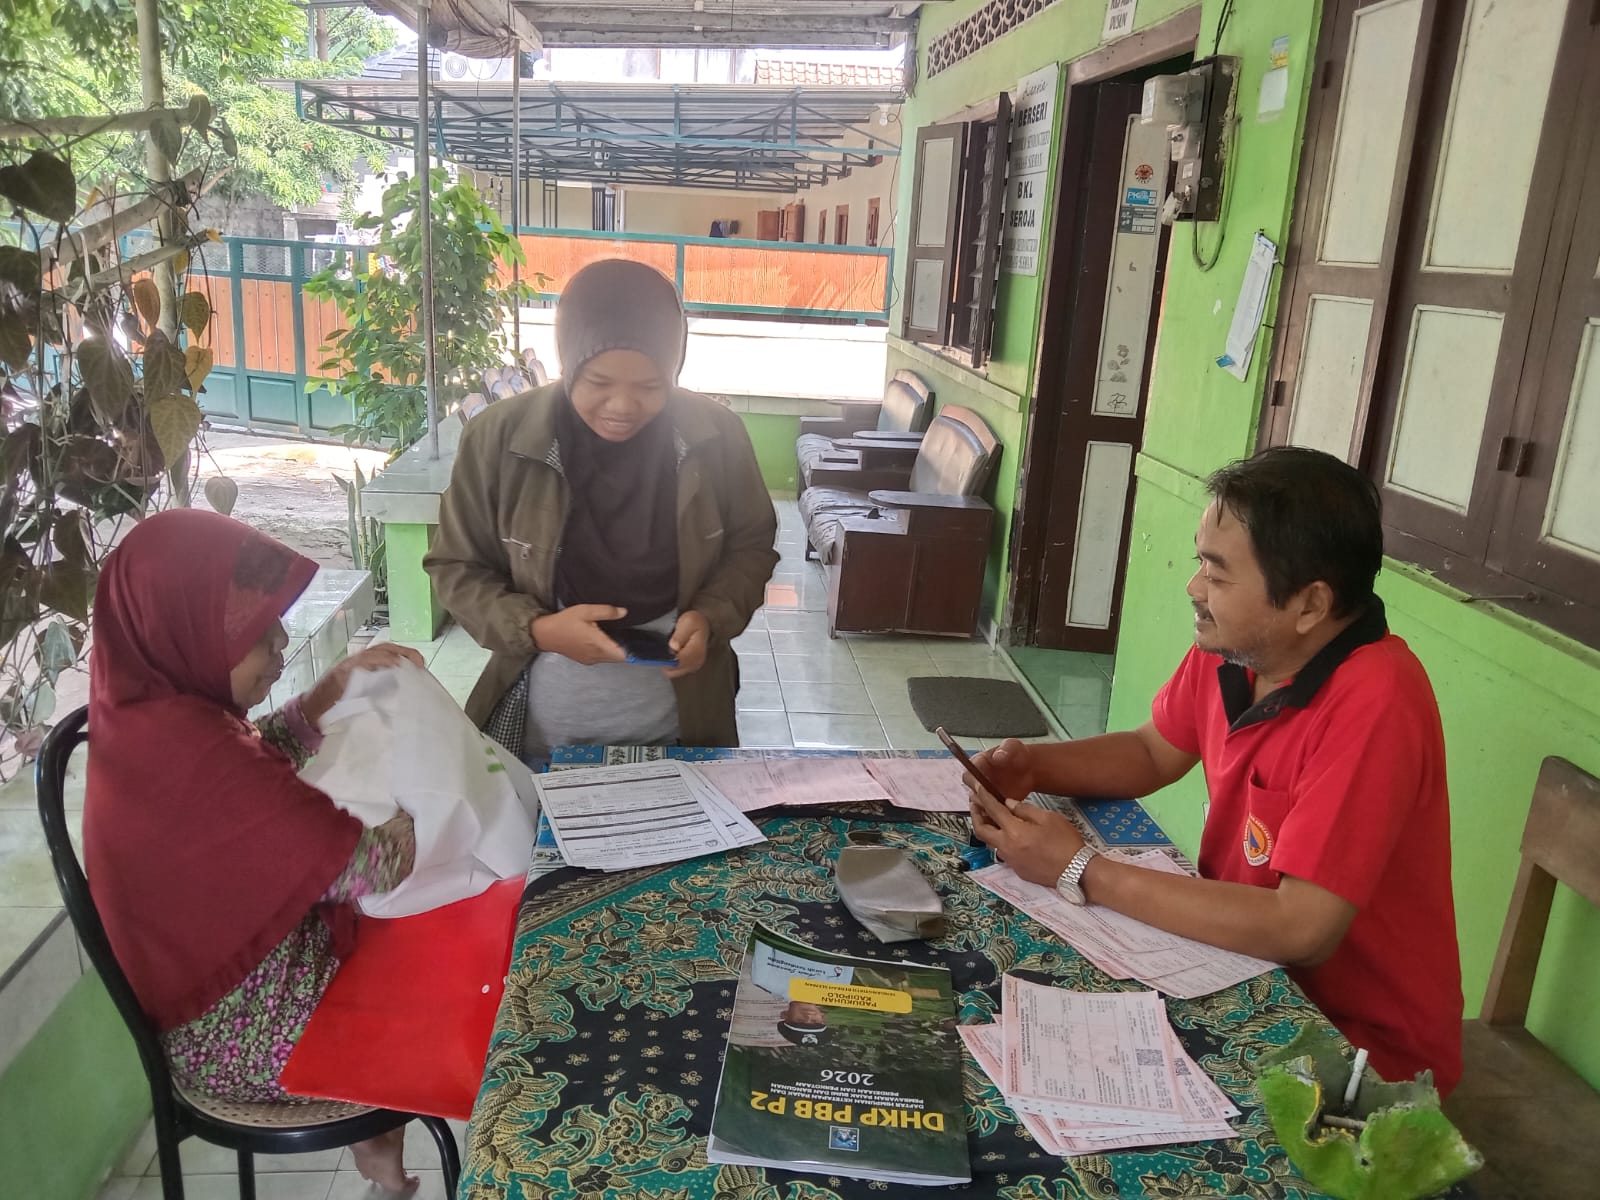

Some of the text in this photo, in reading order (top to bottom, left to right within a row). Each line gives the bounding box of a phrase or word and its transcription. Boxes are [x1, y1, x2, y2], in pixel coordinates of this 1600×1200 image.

[1018, 101, 1048, 127] BERSERI
[1017, 181, 1033, 199] BKL
[1010, 209, 1035, 228] SEROJA
[822, 996, 878, 1008] PADUKUHAN
[827, 991, 872, 1002] KADIPOLO
[820, 1069, 874, 1086] 2026
[751, 1090, 945, 1132] DHKP PBB P2
